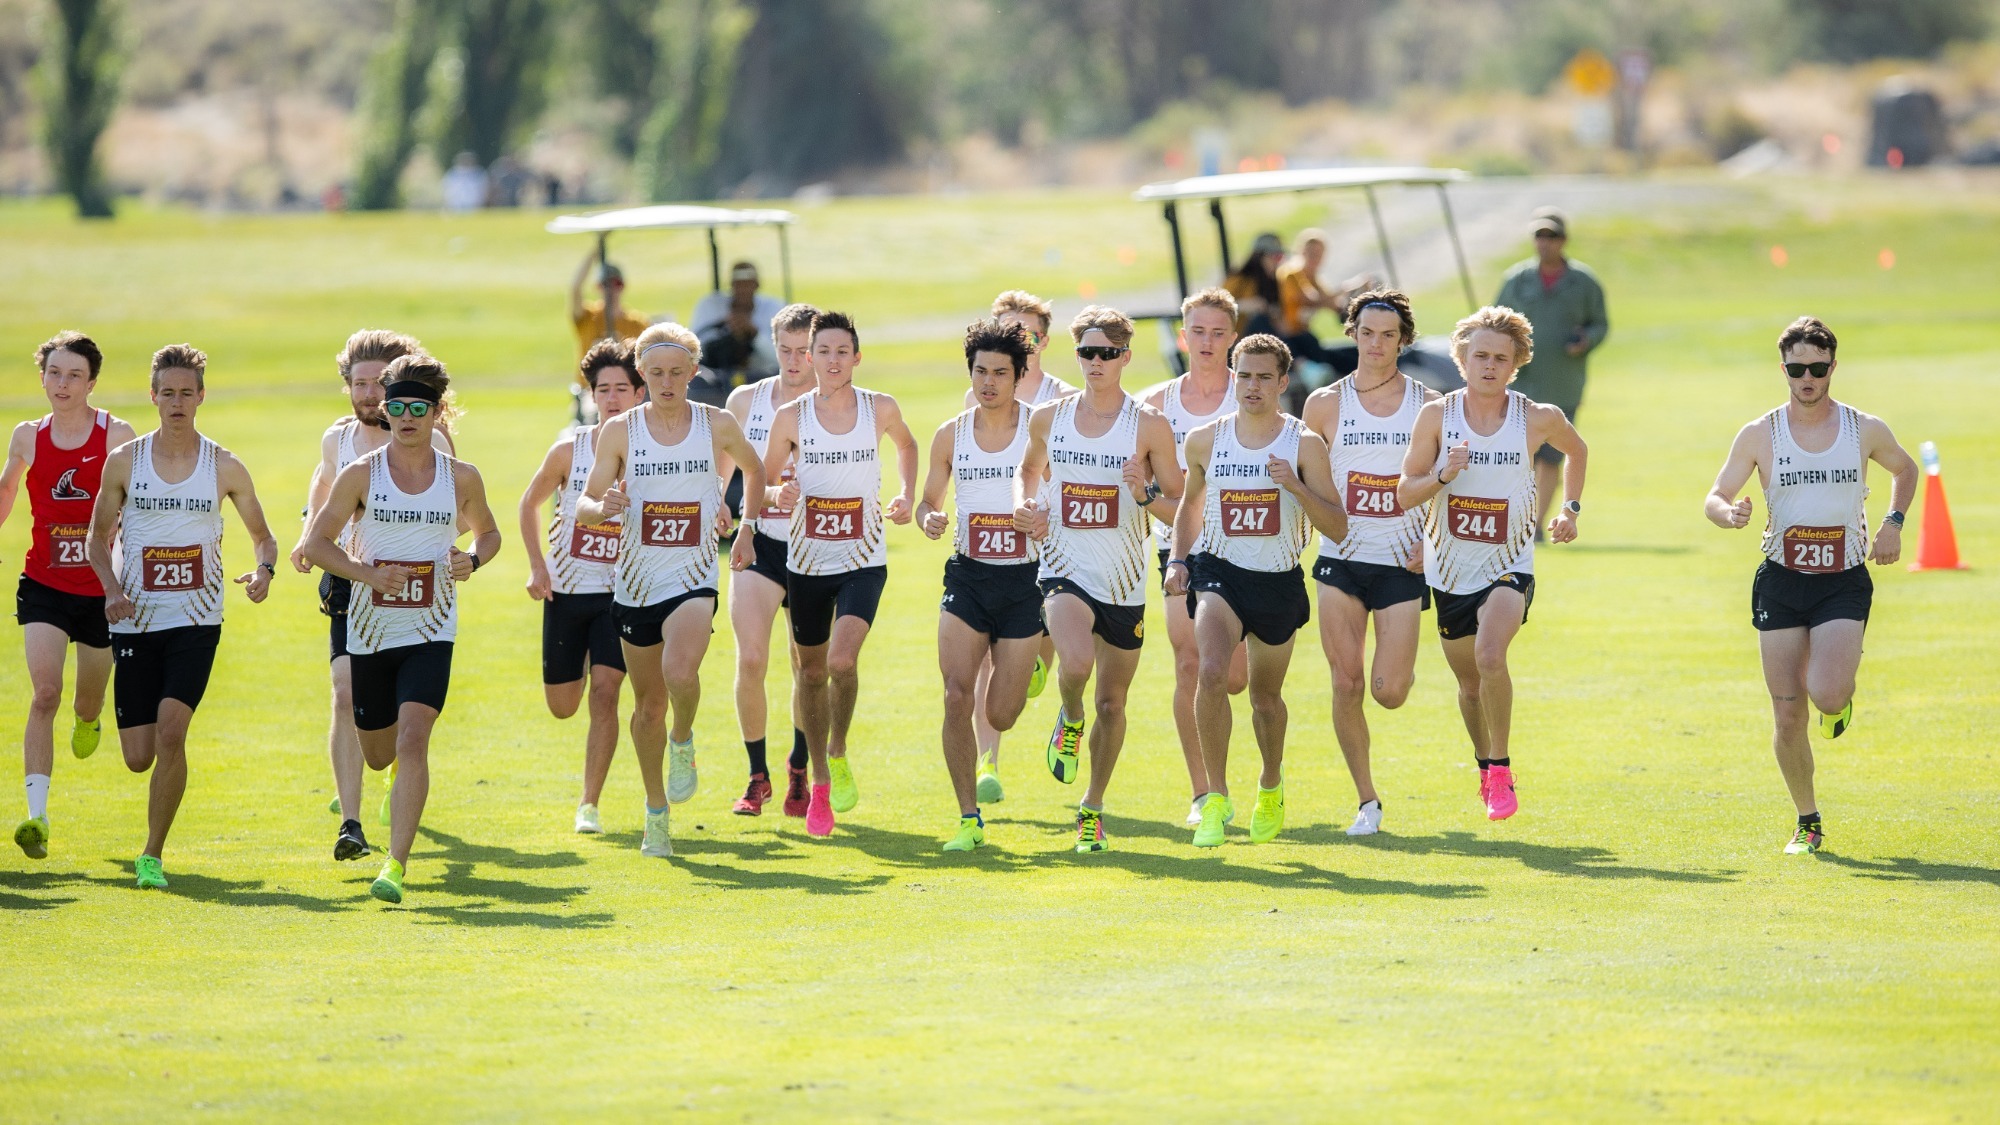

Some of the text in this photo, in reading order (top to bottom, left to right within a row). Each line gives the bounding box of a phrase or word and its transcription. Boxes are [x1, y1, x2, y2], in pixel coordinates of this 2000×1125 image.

[1343, 433, 1388, 446] SOUTHERN
[804, 449, 875, 464] SOUTHERN IDAHO
[1053, 450, 1097, 467] SOUTHERN
[1494, 452, 1520, 465] IDAHO
[635, 460, 708, 476] SOUTHERN IDAHO
[958, 467, 1002, 480] SOUTHERN
[1215, 464, 1260, 477] SOUTHERN
[1349, 474, 1388, 486] Athletic
[1780, 469, 1857, 486] SOUTHERN IDAHO
[1063, 485, 1101, 496] Athletic
[1221, 492, 1261, 501] Athletic
[135, 497, 212, 512] SOUTHERN IDAHO
[807, 499, 845, 509] Athletic
[1356, 490, 1394, 512] 248
[1449, 498, 1490, 510] Athletic
[644, 504, 685, 514] Athletic
[1069, 501, 1107, 523] 240
[374, 509, 451, 525] SOUTHERN IDAHO
[970, 515, 1011, 525] Athletic
[1230, 507, 1268, 530] 247
[651, 519, 690, 541] 237
[815, 514, 853, 536] 234
[1457, 514, 1497, 537] 244
[1785, 528, 1828, 538] Athletic
[580, 534, 618, 558] 239
[979, 531, 1015, 553] 245
[144, 549, 186, 559] Athletic
[1794, 544, 1834, 566] 236
[154, 563, 193, 586] 235
